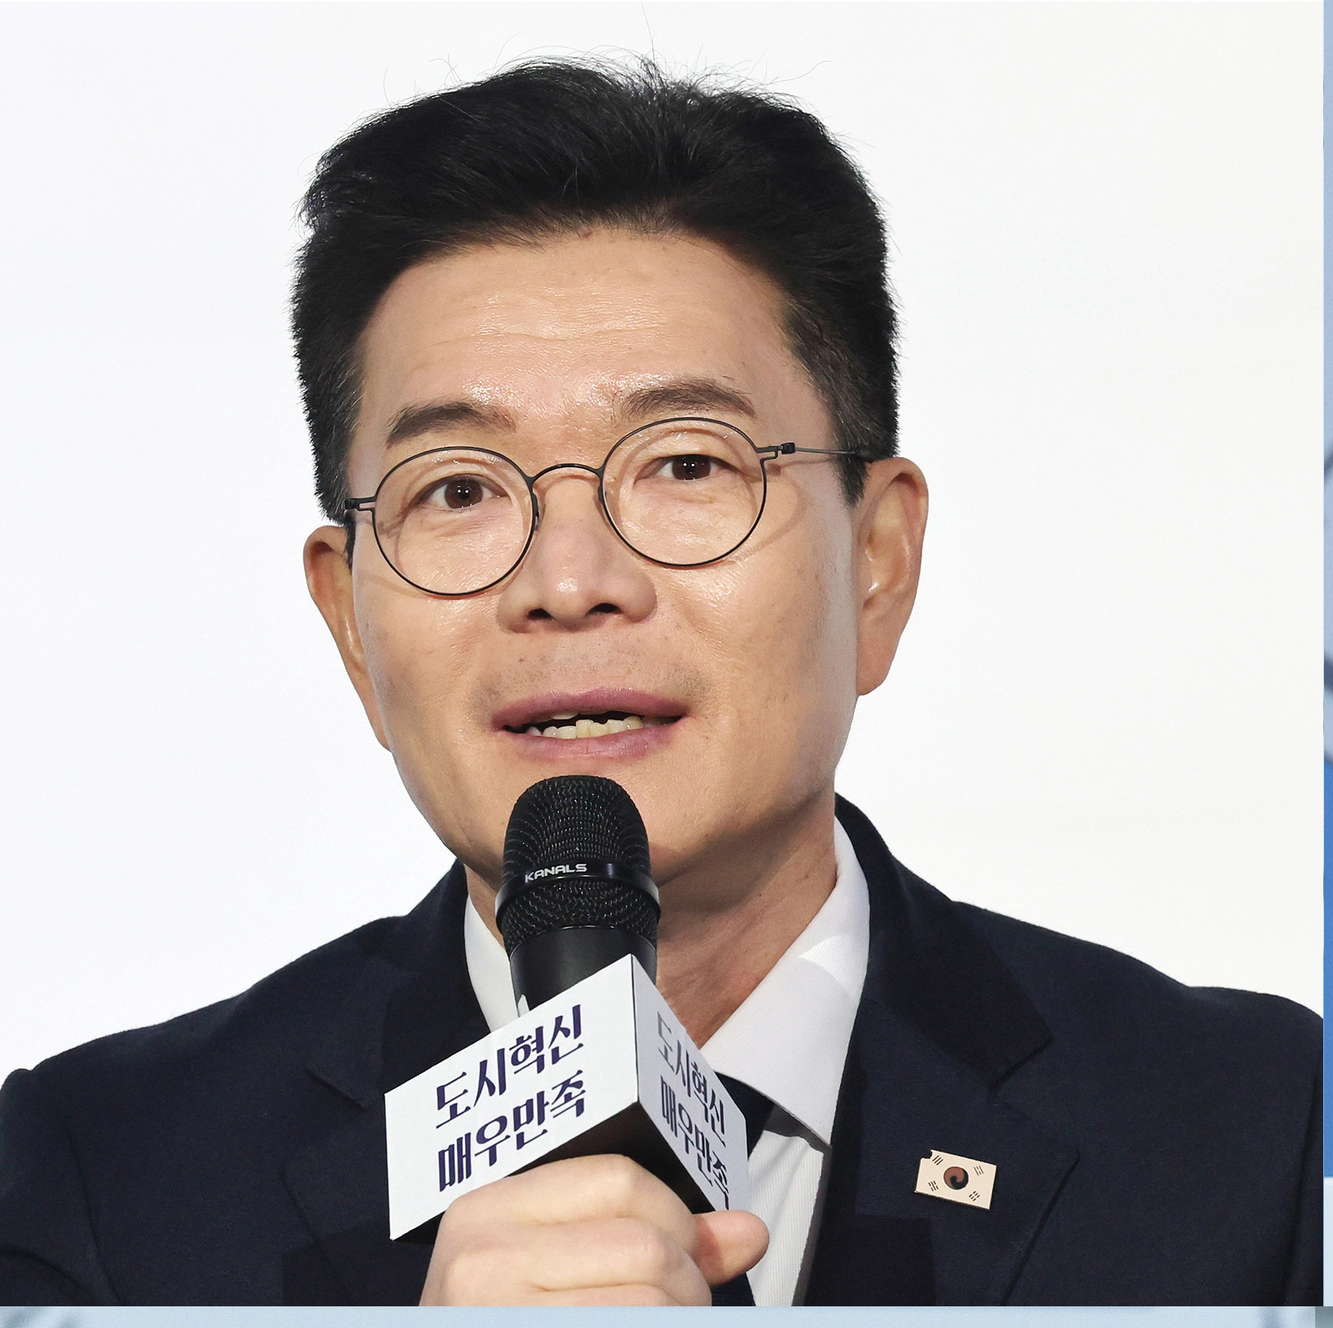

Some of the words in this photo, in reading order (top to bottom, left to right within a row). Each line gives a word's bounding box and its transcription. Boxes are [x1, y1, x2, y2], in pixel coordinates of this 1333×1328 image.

[524, 863, 588, 884] KANALS
[434, 1004, 584, 1130] 도시혁신
[656, 1011, 727, 1148] 도시혁신
[437, 1071, 587, 1192] 매우만족
[660, 1074, 730, 1211] 매우만족
